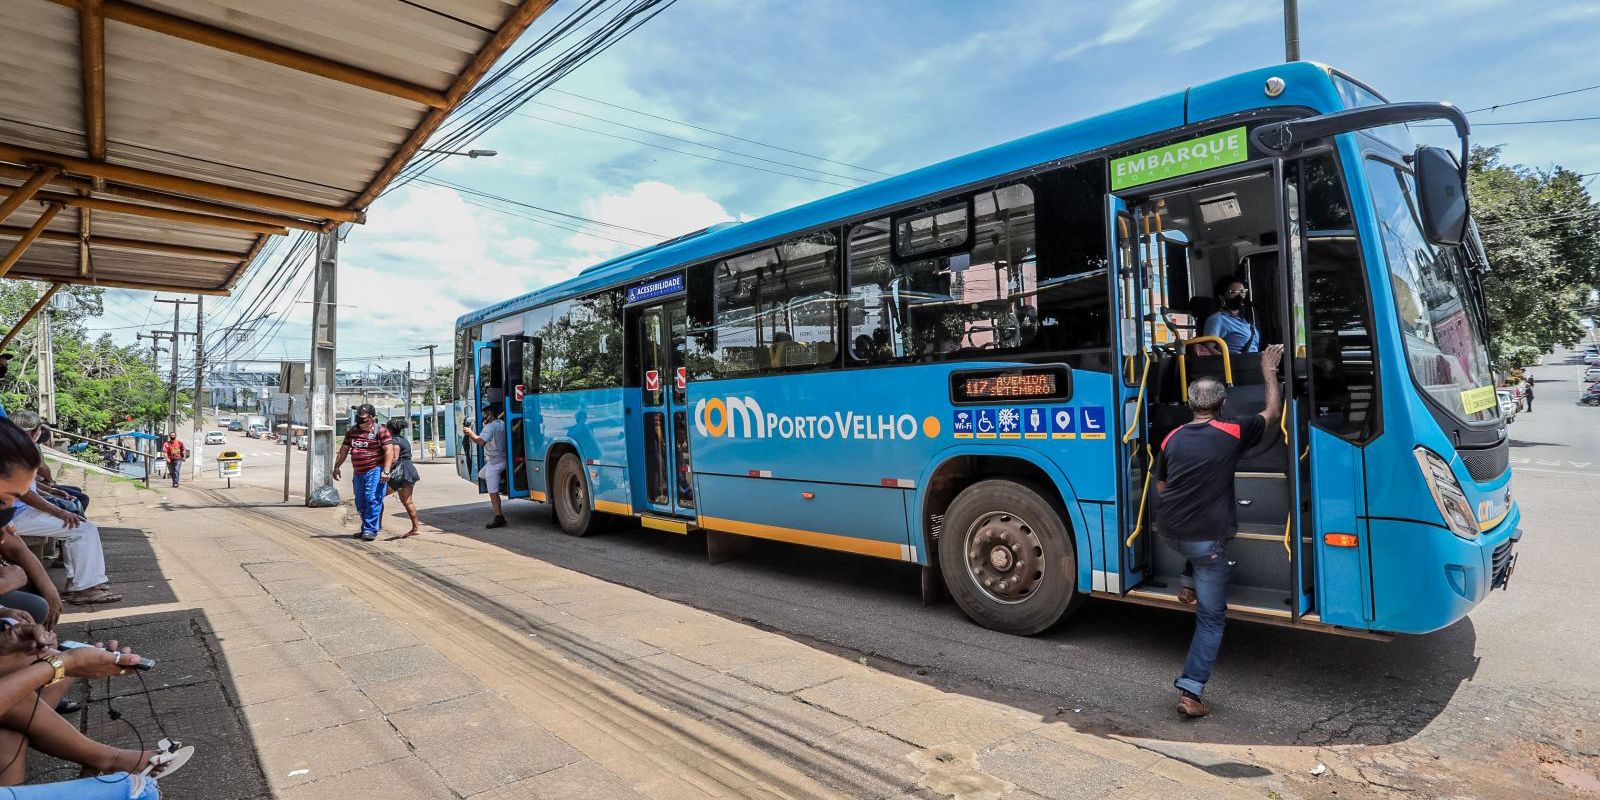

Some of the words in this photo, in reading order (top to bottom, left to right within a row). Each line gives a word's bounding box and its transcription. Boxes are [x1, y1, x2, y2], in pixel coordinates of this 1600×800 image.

[1117, 134, 1240, 177] EMBARQUE
[637, 277, 680, 295] ACESSIBILIDADE
[996, 375, 1047, 386] AVENIDA
[965, 381, 988, 394] 117
[990, 385, 1050, 396] SETEMBRO
